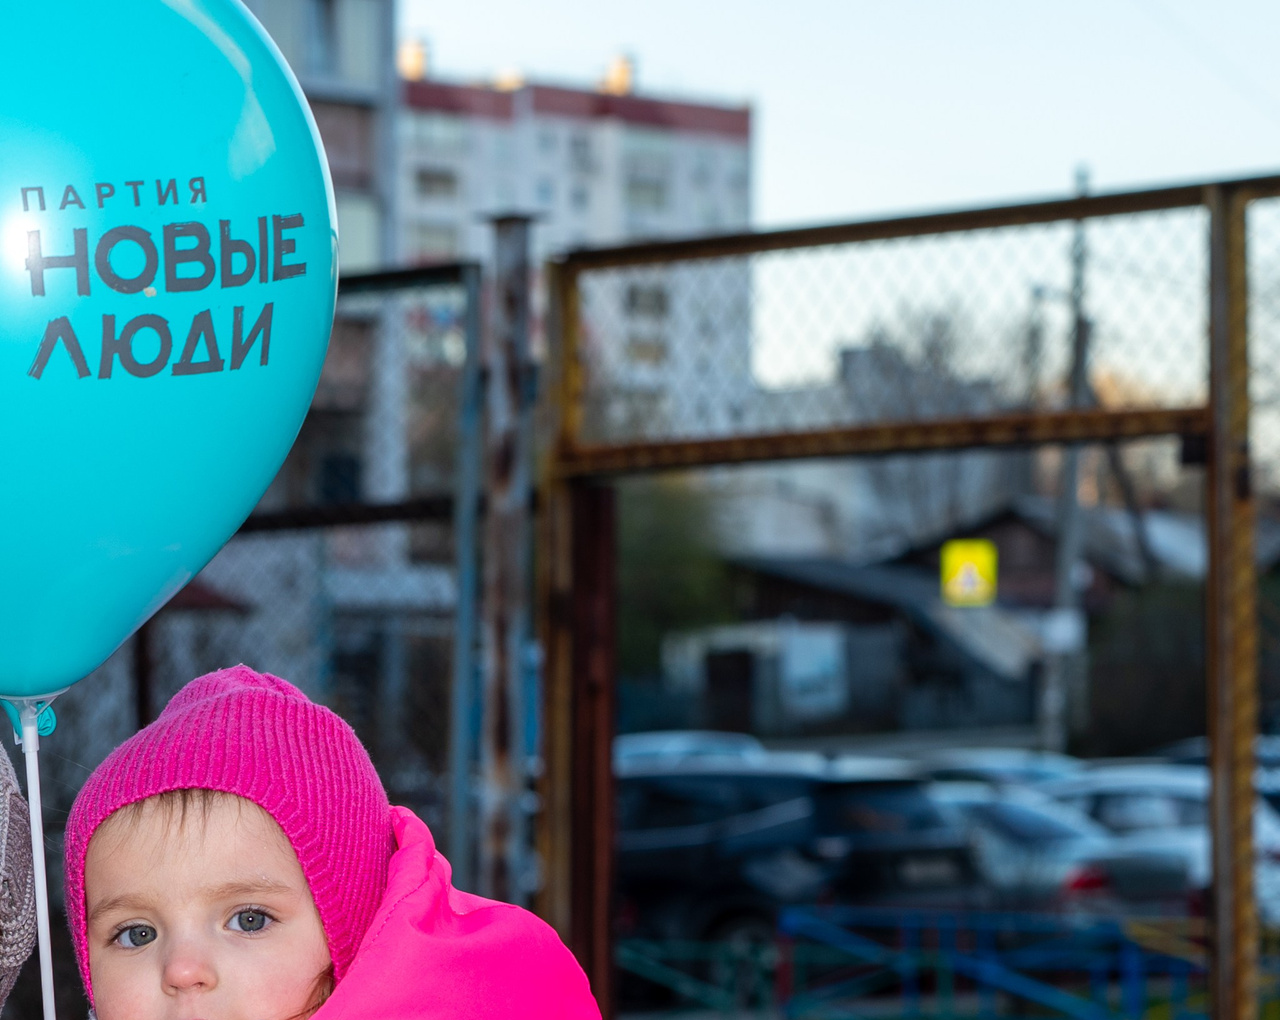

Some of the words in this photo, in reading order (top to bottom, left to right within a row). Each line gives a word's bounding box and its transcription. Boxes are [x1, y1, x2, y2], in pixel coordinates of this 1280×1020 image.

[22, 177, 207, 211] ПАРТИЯ
[26, 213, 307, 296] НОВЫЕ
[27, 302, 274, 379] ЛЮДИ
